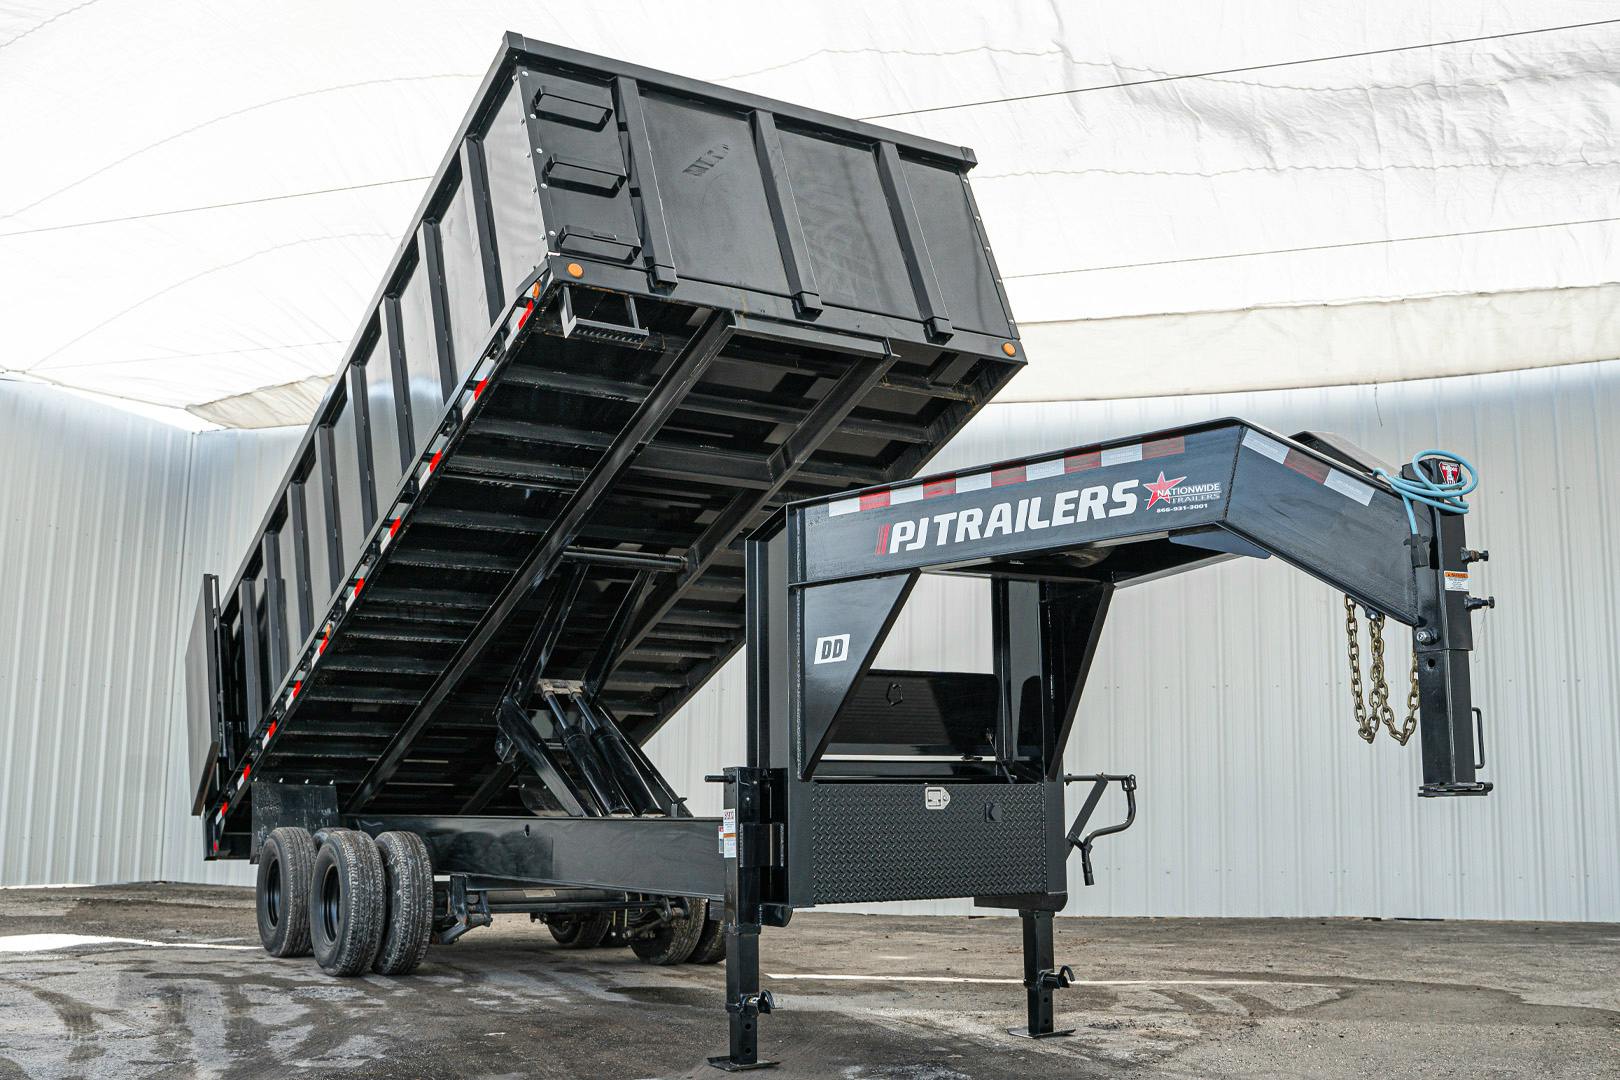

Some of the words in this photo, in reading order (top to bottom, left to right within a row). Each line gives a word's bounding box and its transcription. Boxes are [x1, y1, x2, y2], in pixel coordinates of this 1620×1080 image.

[1157, 483, 1220, 496] NATIONWIDE
[1172, 493, 1220, 504] TRAILERS
[889, 517, 929, 554] PJ
[934, 479, 1139, 546] TRAILERS
[821, 639, 843, 660] DD
